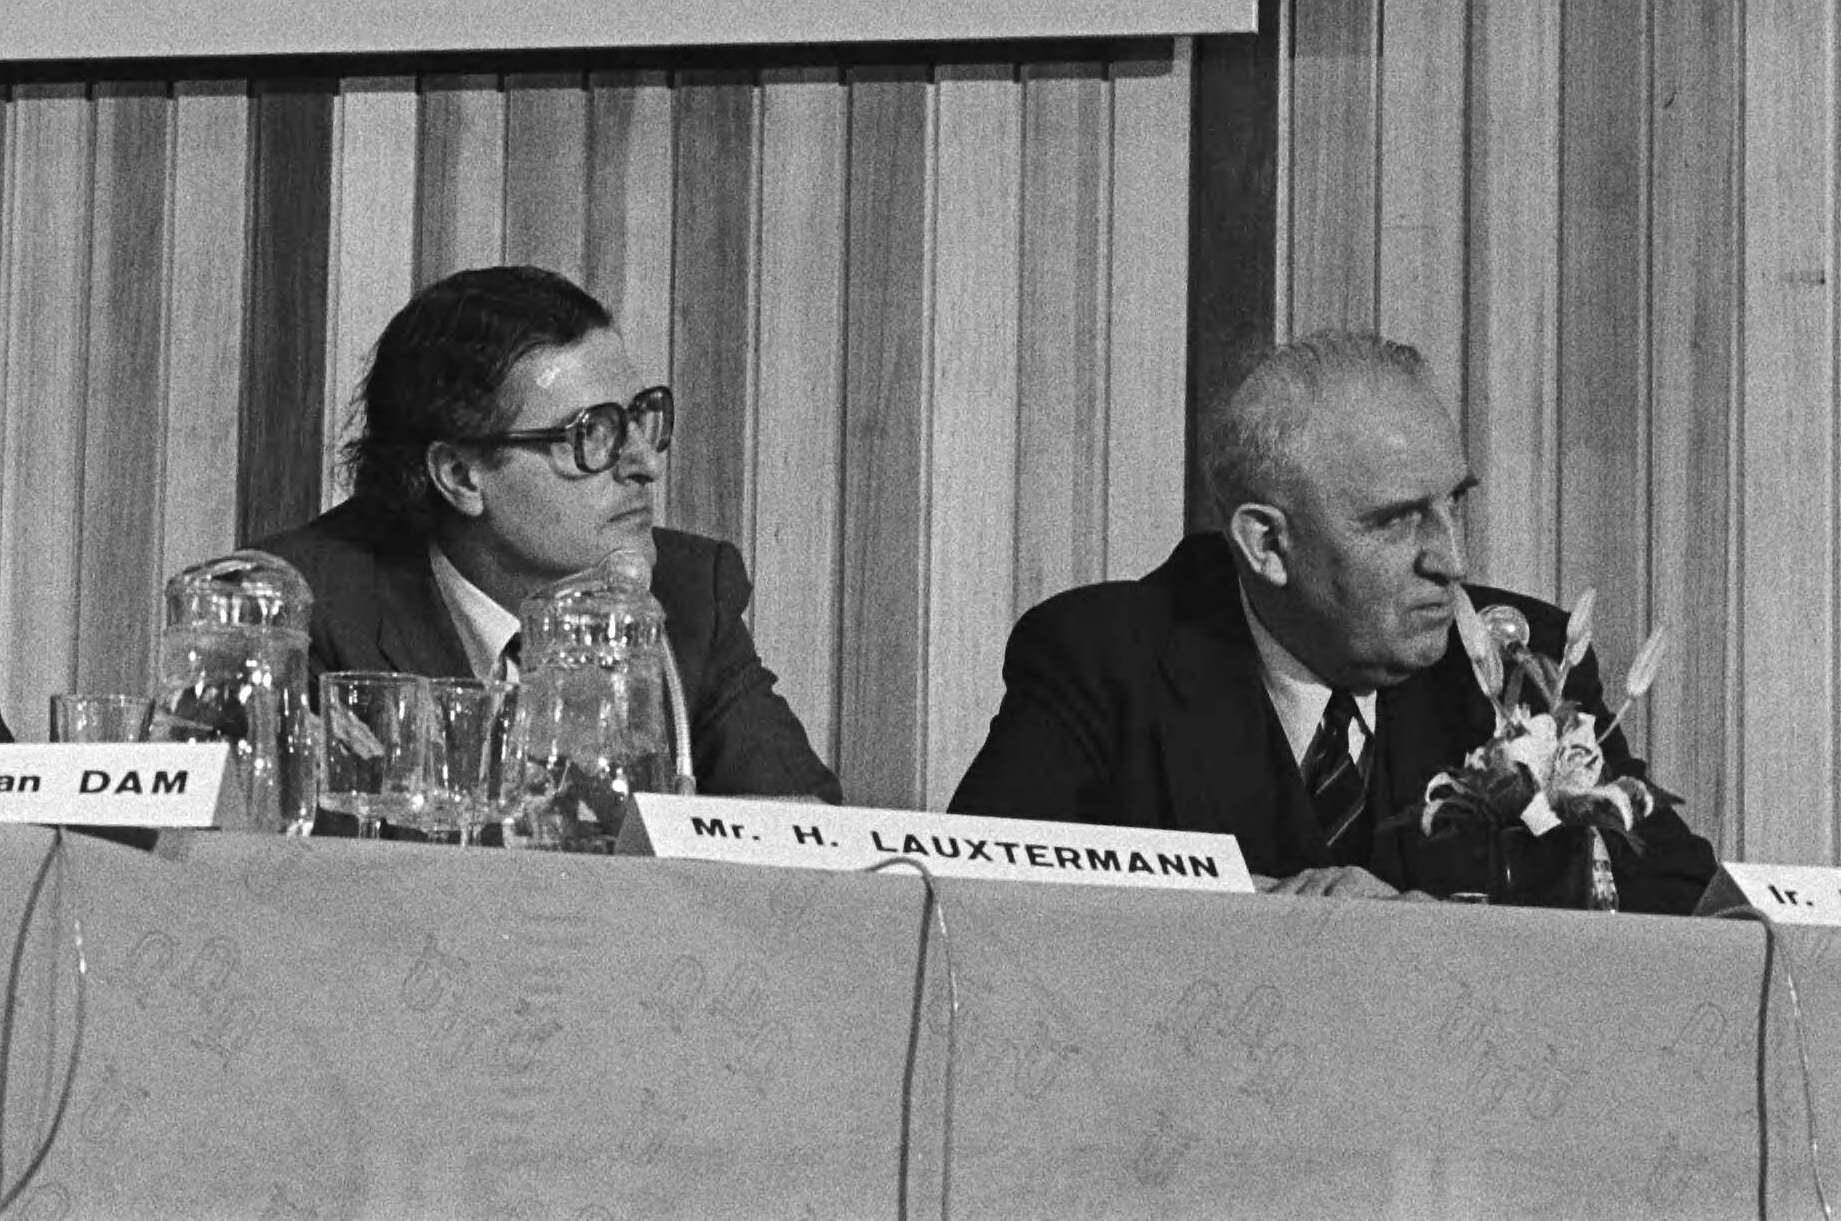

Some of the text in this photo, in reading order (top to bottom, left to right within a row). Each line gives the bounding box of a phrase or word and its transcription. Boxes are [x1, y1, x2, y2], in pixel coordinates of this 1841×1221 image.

[78, 769, 189, 795] DAM
[690, 816, 1220, 879] Mr. H. LAUXTERMANN
[1767, 884, 1814, 907] Ir.
